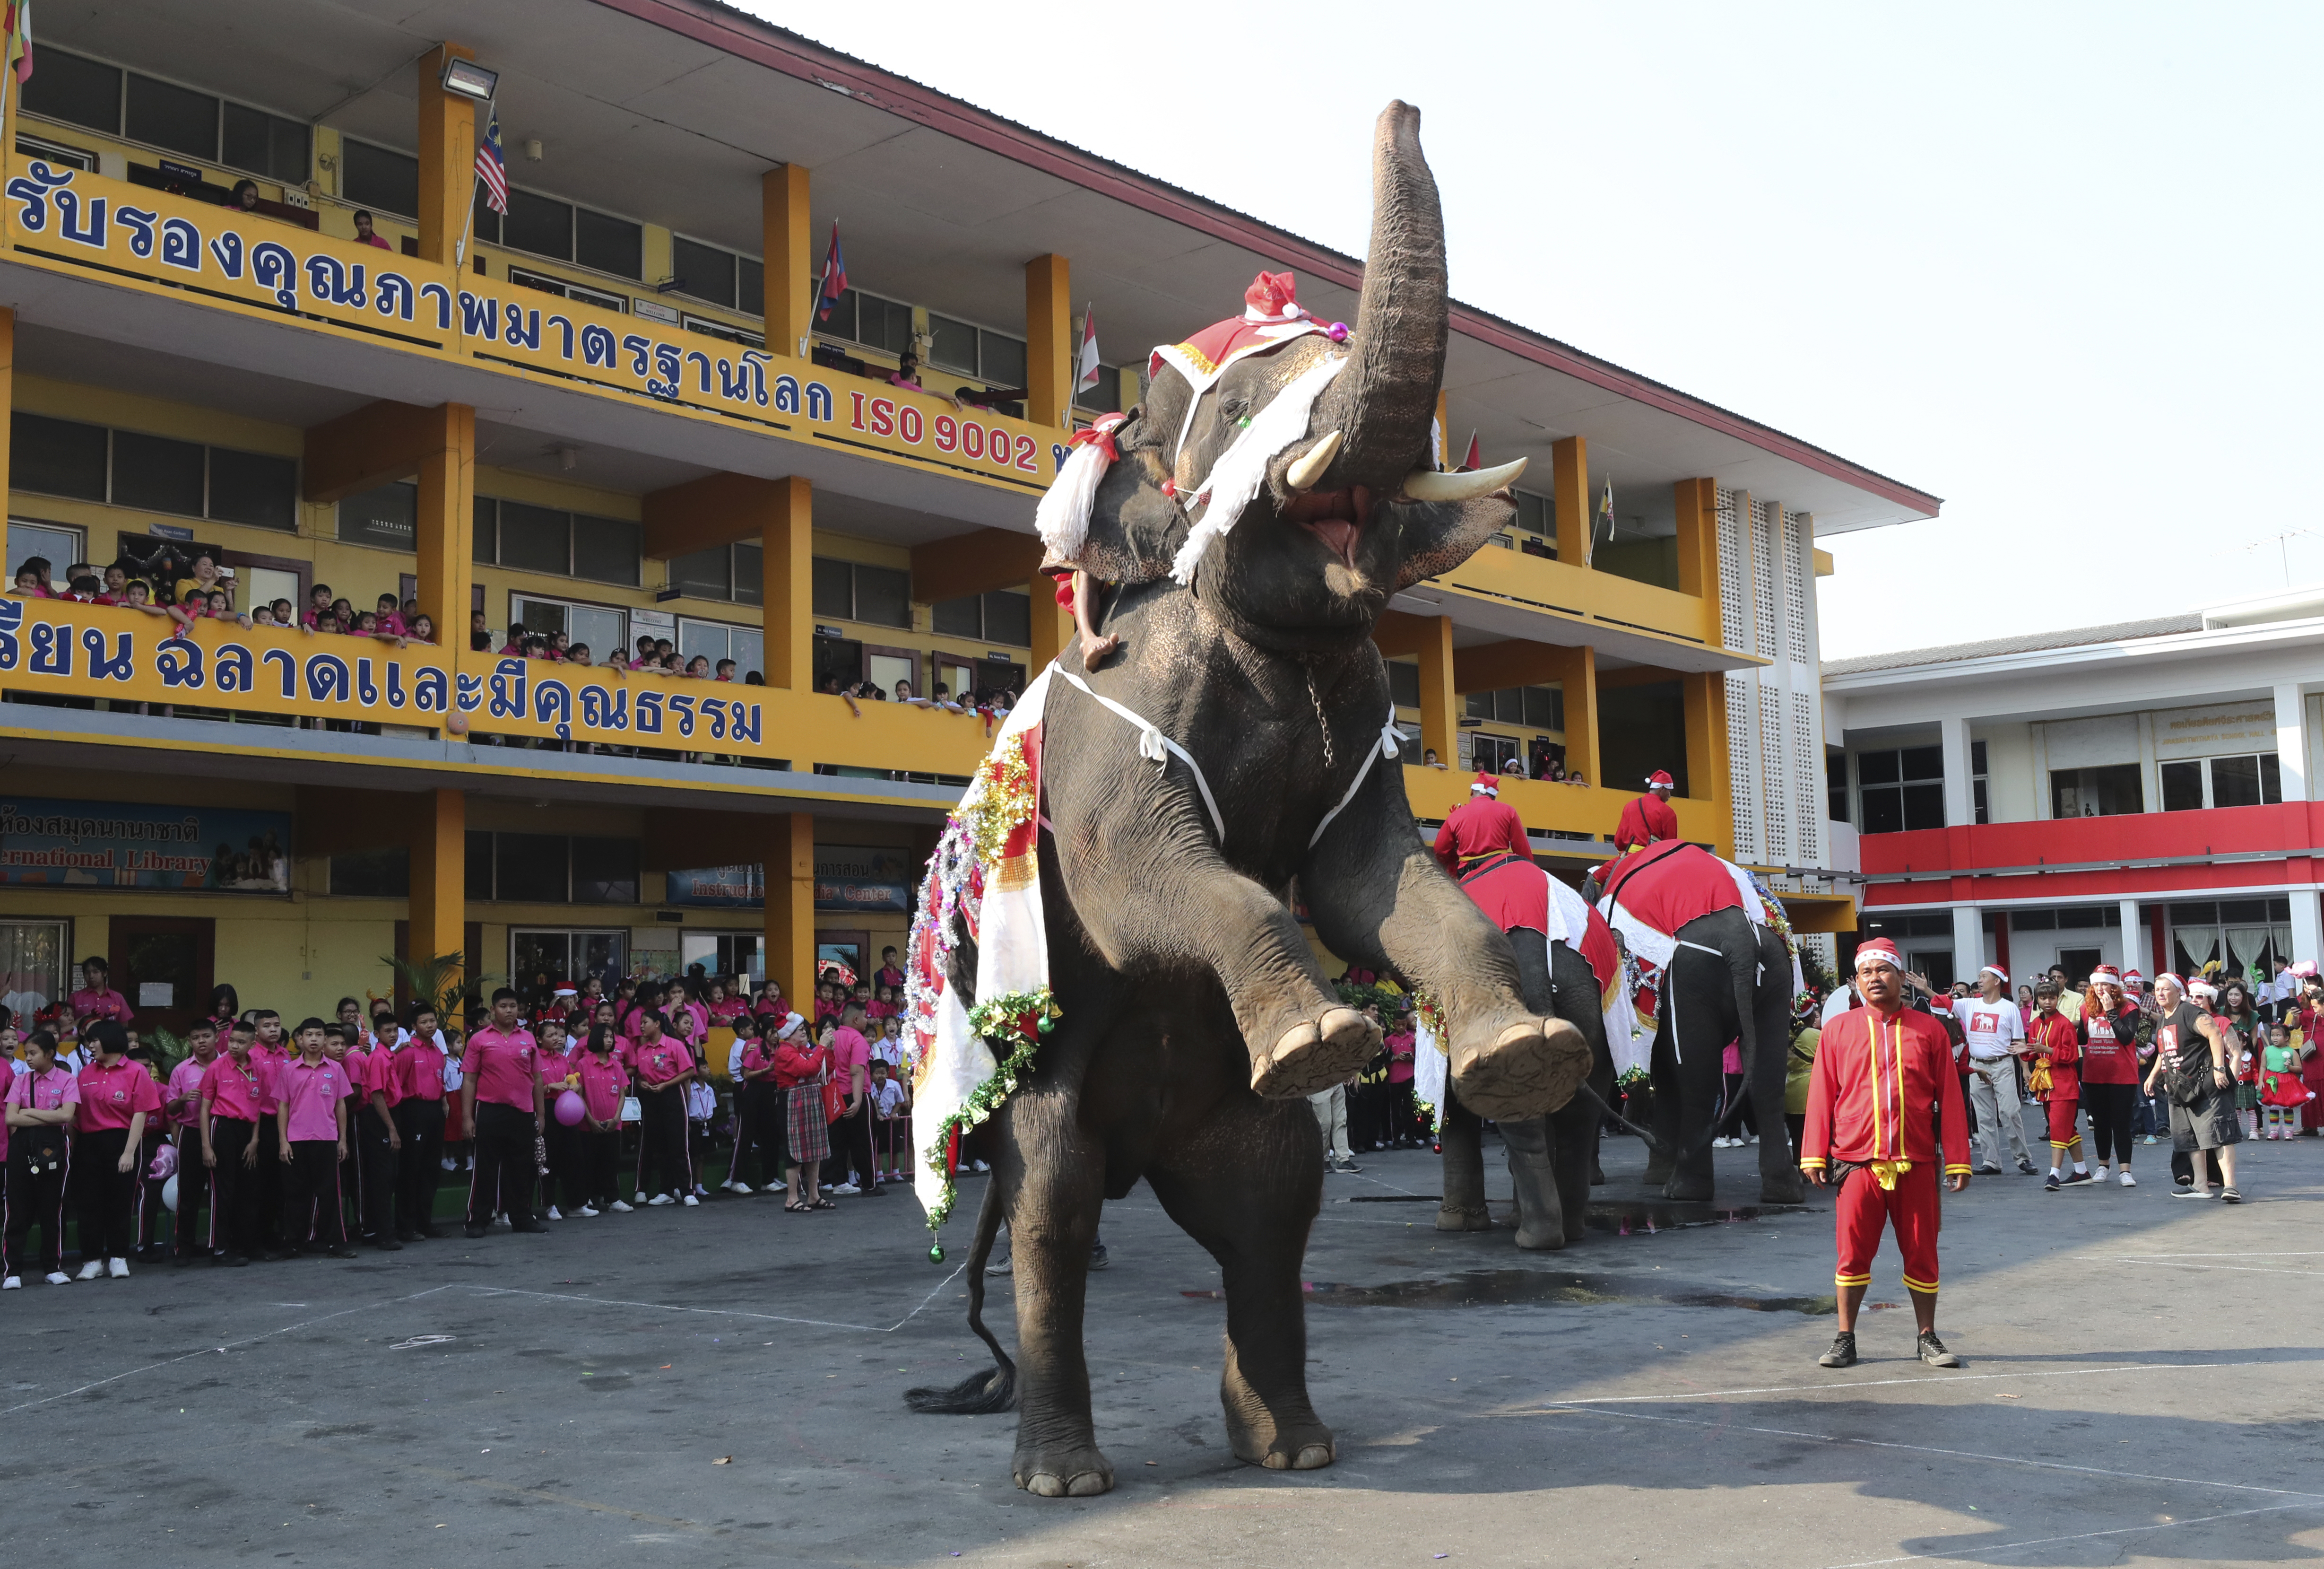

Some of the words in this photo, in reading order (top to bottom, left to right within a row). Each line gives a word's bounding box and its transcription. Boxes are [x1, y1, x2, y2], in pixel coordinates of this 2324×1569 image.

[646, 309, 665, 317] WELCOME
[851, 391, 923, 445] ISO
[934, 414, 1037, 473] 9002
[2221, 732, 2246, 740] SCHOOL
[0, 805, 199, 846] ห้องสมุดนานาชาติ
[125, 849, 212, 877] Library
[691, 878, 764, 898] Instructio
[814, 884, 833, 900] dia
[844, 884, 892, 902] Center
